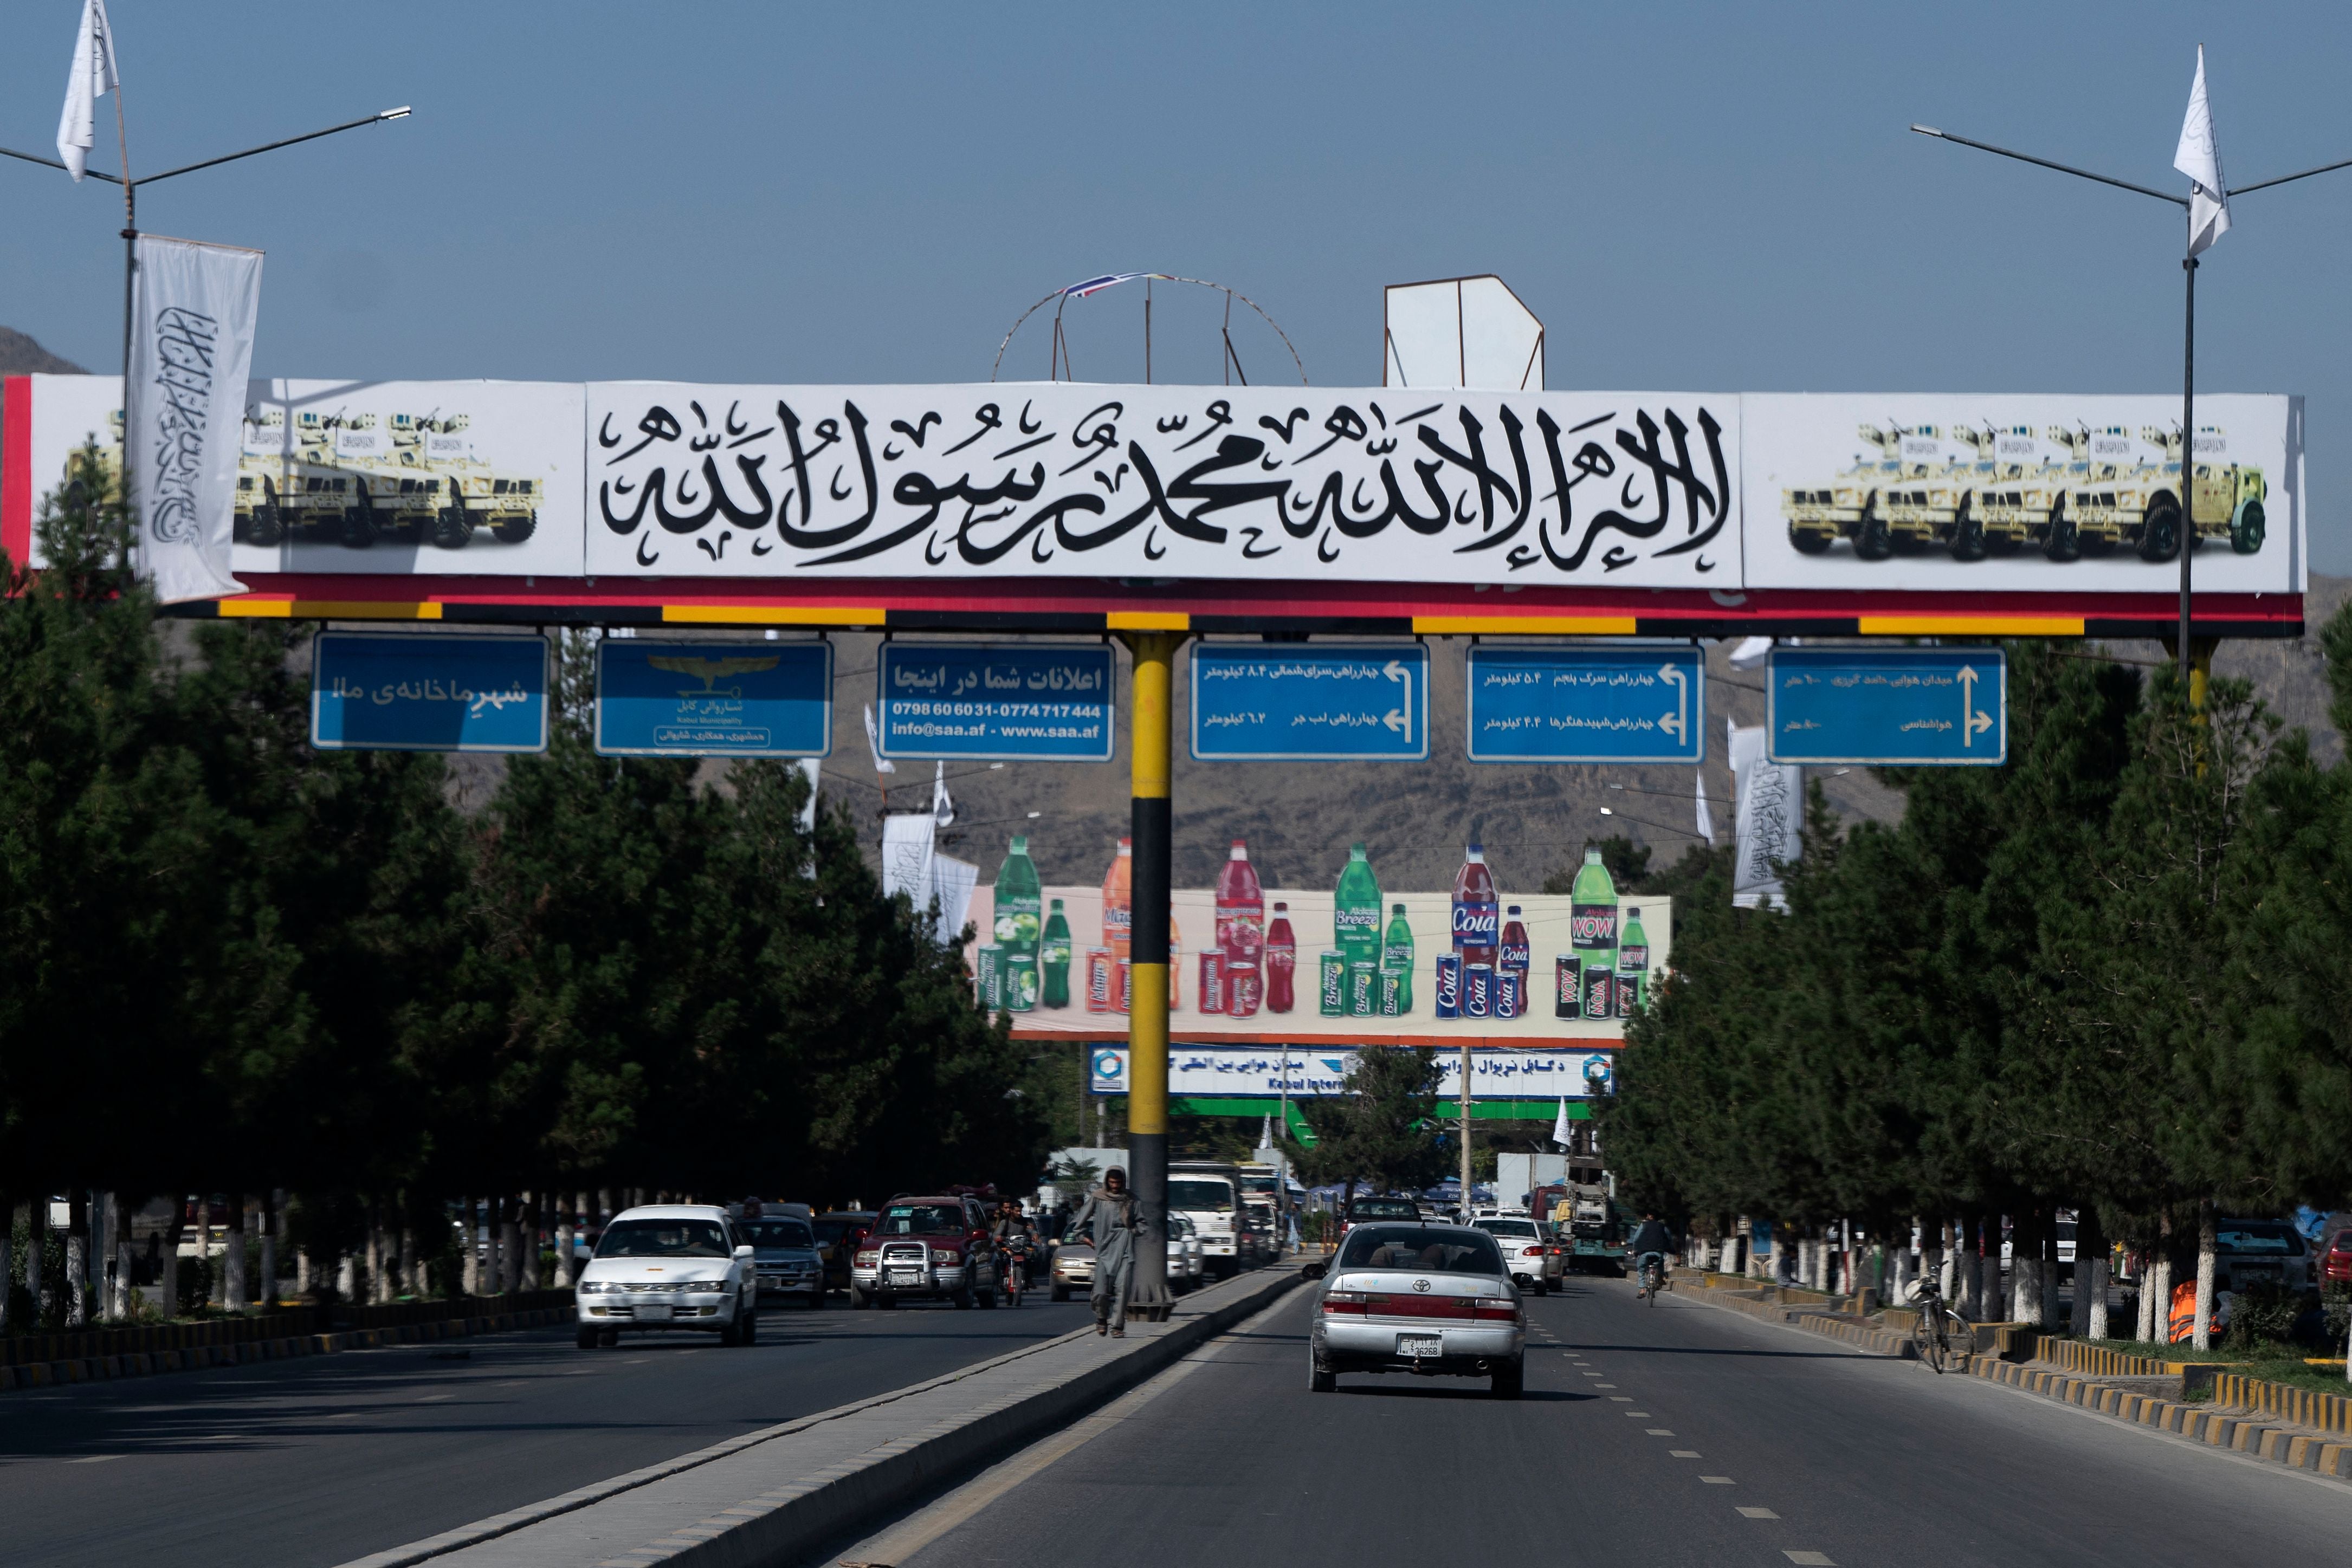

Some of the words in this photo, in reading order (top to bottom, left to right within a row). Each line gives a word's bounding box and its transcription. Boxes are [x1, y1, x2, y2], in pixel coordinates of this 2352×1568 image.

[894, 665, 946, 694] اینجا
[952, 670, 978, 696] در
[984, 666, 1020, 690] شما
[1027, 666, 1102, 691] اعلانات
[1922, 674, 1953, 686] میدان
[893, 703, 931, 716] 0798
[1043, 704, 1070, 717] 717
[1072, 705, 1101, 718] 444
[892, 722, 986, 737] info@saa.af
[1001, 723, 1100, 738] www.saa.af
[1336, 910, 1377, 924] Breeze
[1452, 906, 1496, 931] Cola
[1572, 917, 1614, 938] WOW
[1386, 948, 1411, 956] Breeze
[1501, 945, 1528, 961] Cola
[1621, 952, 1645, 964] WOW
[1325, 967, 1337, 1006] Breeze
[1356, 977, 1366, 1013] Breeze
[1384, 982, 1394, 1014] Breeze
[1437, 968, 1456, 1008] Cola
[1468, 979, 1486, 1015] Cola
[1561, 969, 1577, 1003] WOW
[1591, 980, 1605, 1015] WOW
[1497, 984, 1513, 1017] Cola
[1522, 1059, 1554, 1075] کابل
